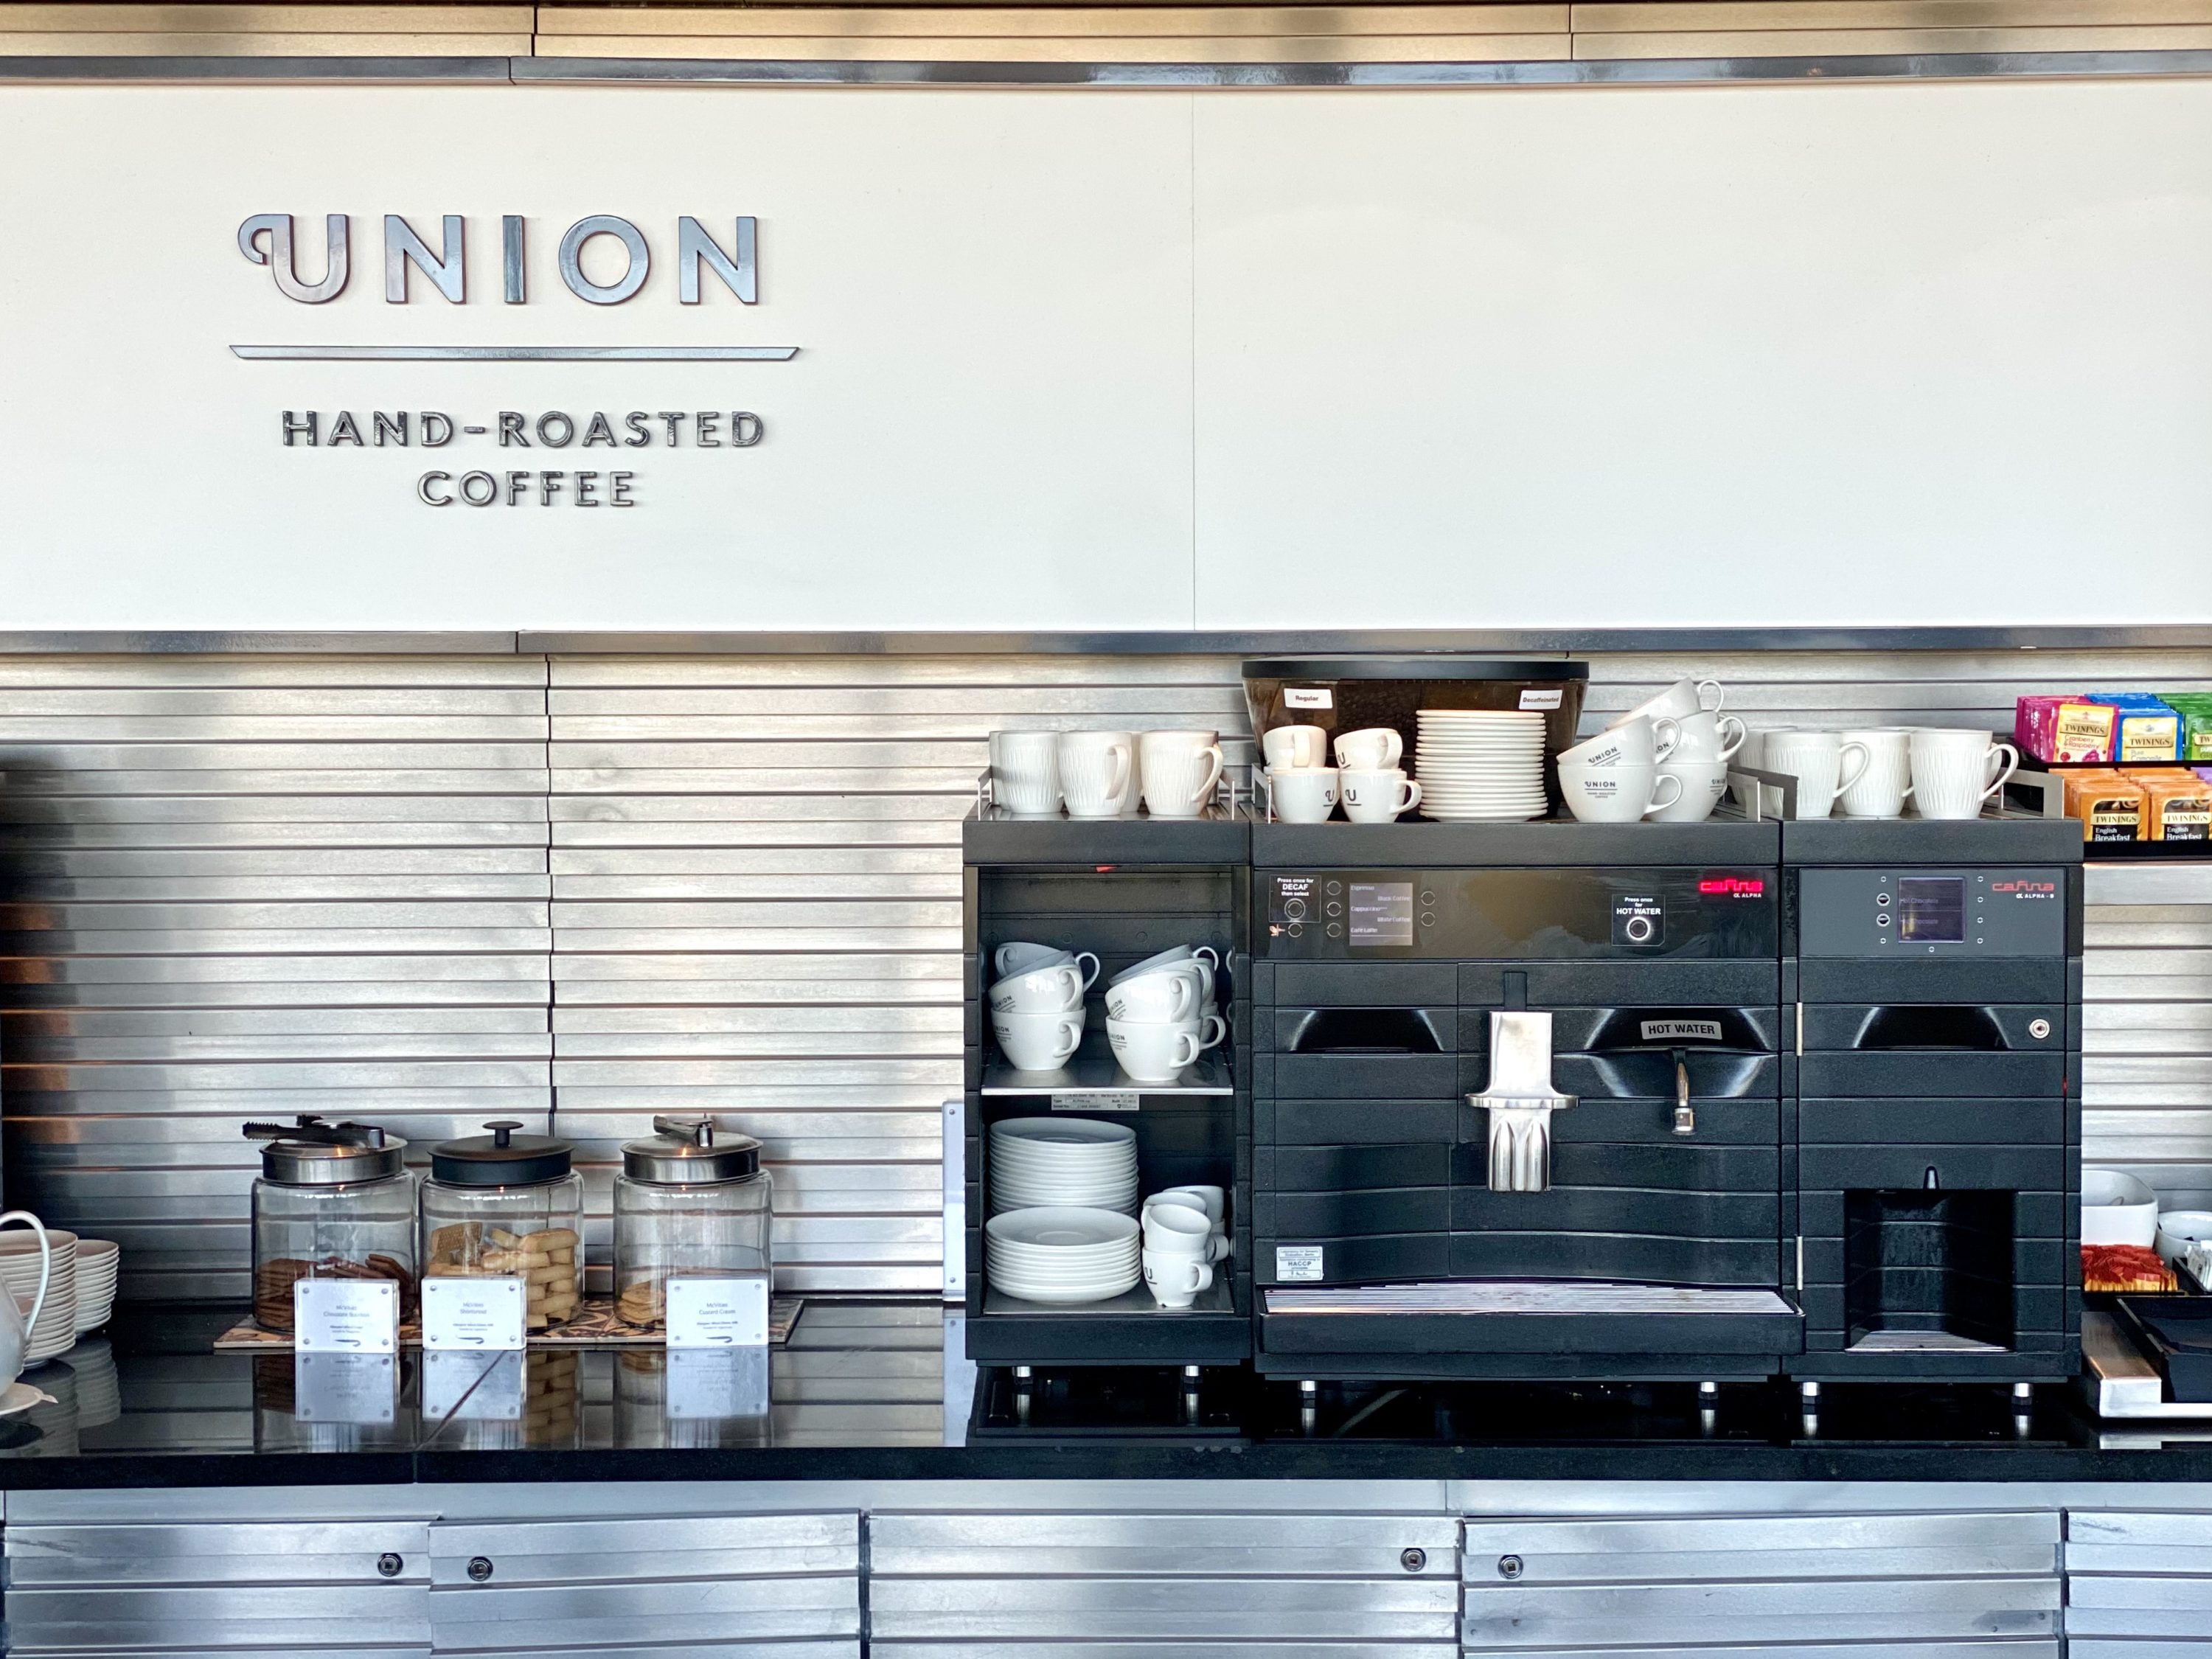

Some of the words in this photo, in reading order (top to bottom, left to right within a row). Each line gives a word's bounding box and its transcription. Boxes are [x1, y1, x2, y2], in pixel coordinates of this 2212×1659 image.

[237, 213, 758, 305] UNION
[282, 410, 764, 448] HAND-ROASTED
[417, 470, 635, 507] COFFEE
[1295, 695, 1319, 703] Regular
[1523, 695, 1559, 703] Decaffeinated
[2065, 724, 2105, 734] TWININGS
[2065, 734, 2095, 744] Cranberry
[2130, 738, 2170, 746] TWININGS
[1587, 746, 1618, 764] UNION
[2096, 815, 2137, 824] TWININGS
[1648, 1024, 1672, 1034] HOT
[1674, 1023, 1715, 1034] WATER
